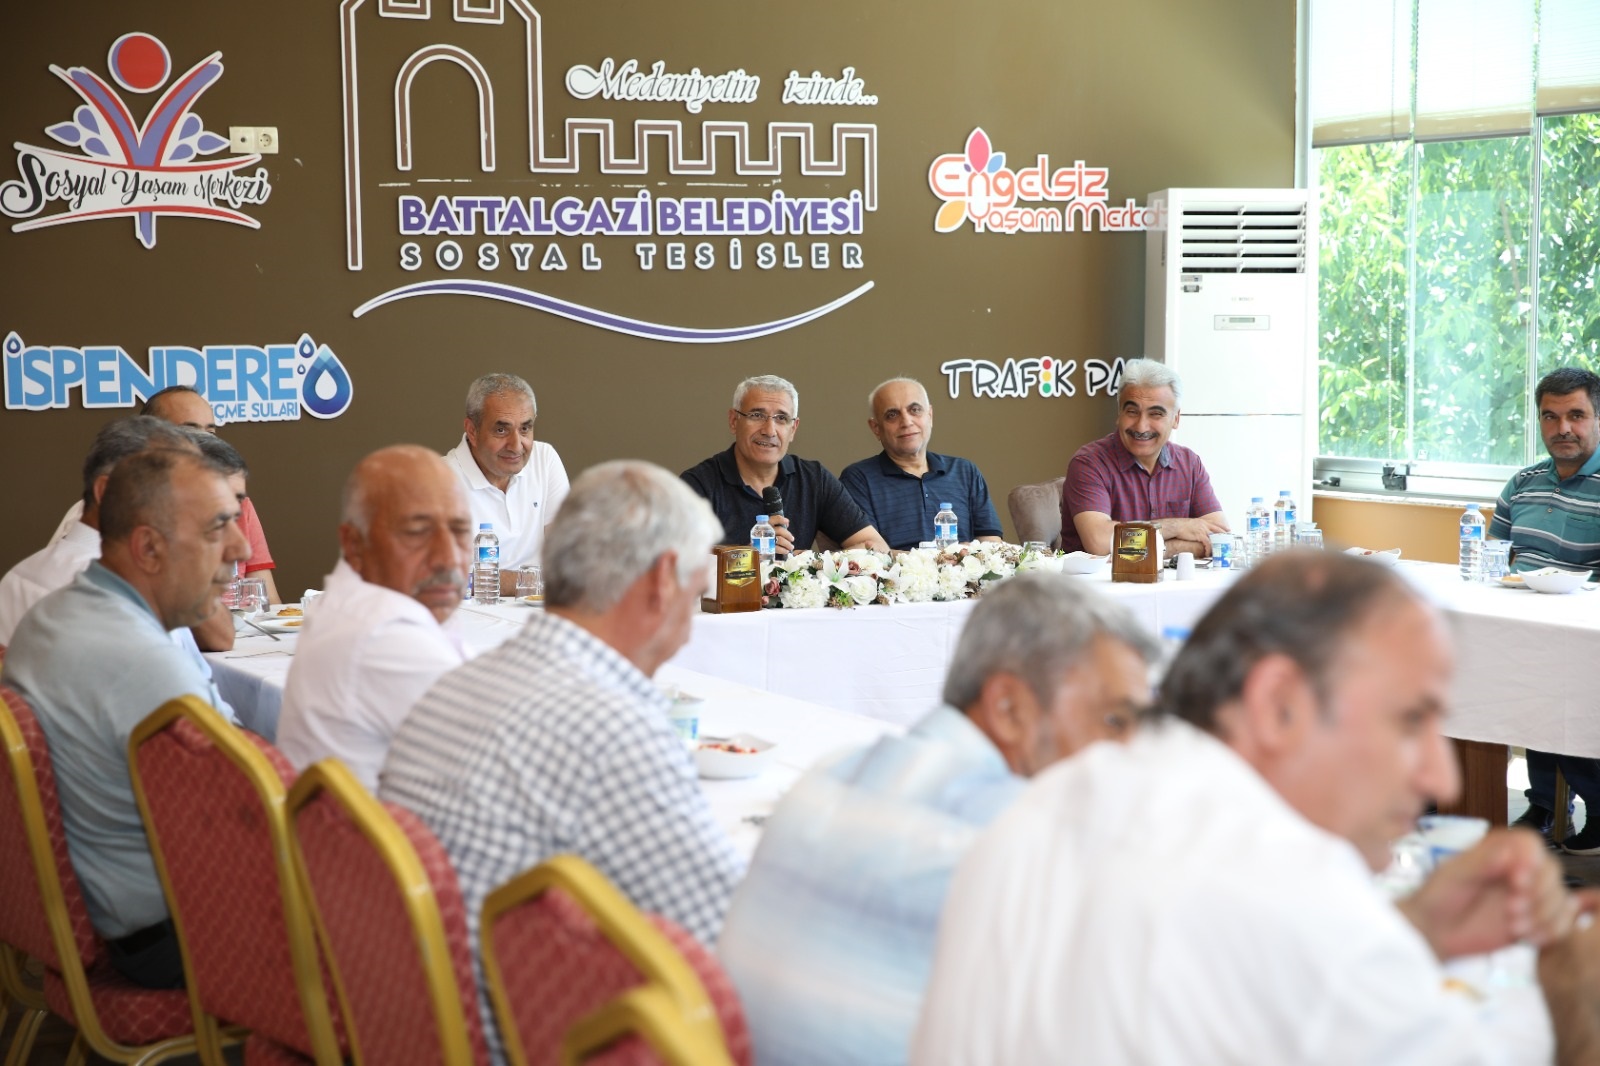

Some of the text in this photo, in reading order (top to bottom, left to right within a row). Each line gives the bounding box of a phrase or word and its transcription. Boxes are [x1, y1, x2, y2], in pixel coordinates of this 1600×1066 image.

[568, 58, 758, 111] Medeniyetin
[1, 153, 268, 214] Sosyal Yaşam Merkezi
[931, 156, 1107, 207] Engelsiz
[402, 192, 861, 232] BATTALGAZİ BELEDİYESİ
[967, 202, 1062, 230] Yaşam
[402, 241, 861, 267] SOSYAL TESİSLER
[1087, 360, 1126, 394] PA
[211, 401, 298, 422] ÇME SULARI
